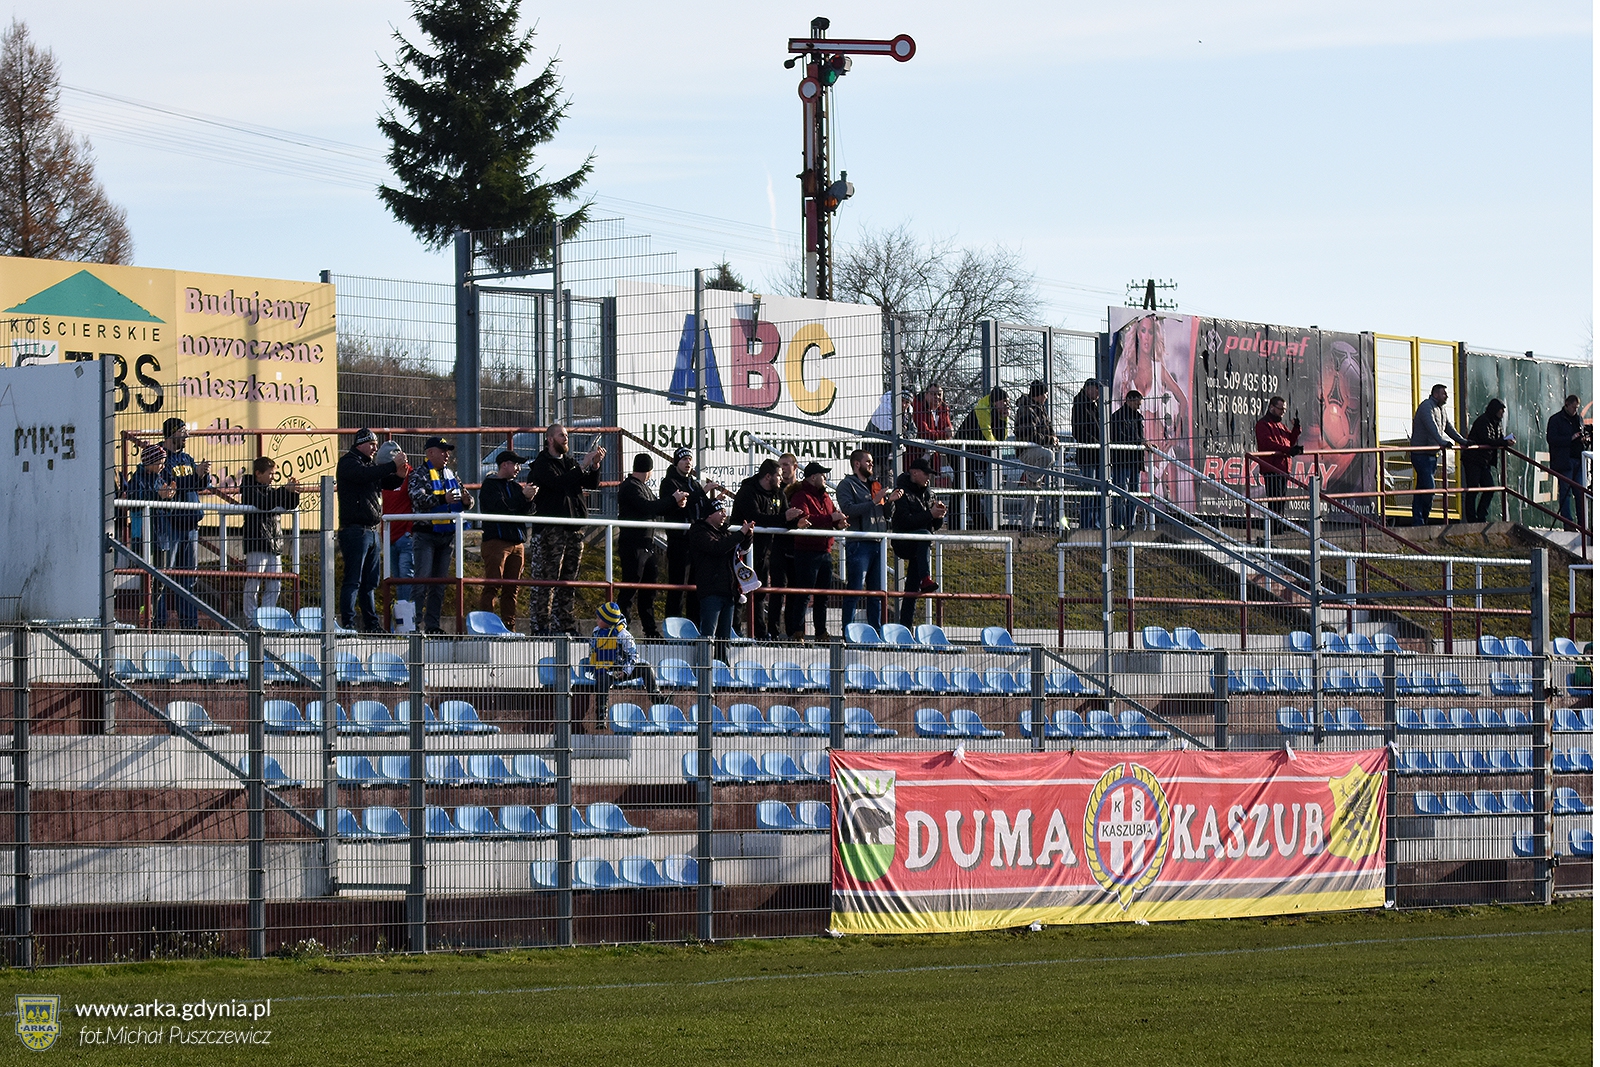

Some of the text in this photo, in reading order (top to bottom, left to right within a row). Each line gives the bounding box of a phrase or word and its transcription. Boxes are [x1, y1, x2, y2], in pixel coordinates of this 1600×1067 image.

[184, 287, 311, 329] Budujemy
[10, 318, 161, 342] KOŚCIERSKIE
[1224, 331, 1311, 358] polgraf
[178, 332, 324, 365] nowoczesne
[667, 313, 838, 416] ABC
[178, 370, 320, 406] mieszkania
[1223, 370, 1240, 390] 509
[1242, 373, 1260, 392] 435
[1261, 374, 1279, 393] 839
[1217, 394, 1230, 413] 58
[1231, 396, 1249, 414] 686
[1250, 397, 1262, 416] 39
[205, 417, 246, 446] dla
[725, 428, 856, 460] KOMUNALNE
[296, 445, 331, 475] 9001
[1370, 501, 1376, 514] 2
[1114, 799, 1142, 813] K S
[904, 808, 1080, 870] DUMA
[1101, 823, 1154, 838] KASZUBIA
[1172, 802, 1326, 861] KASZUB
